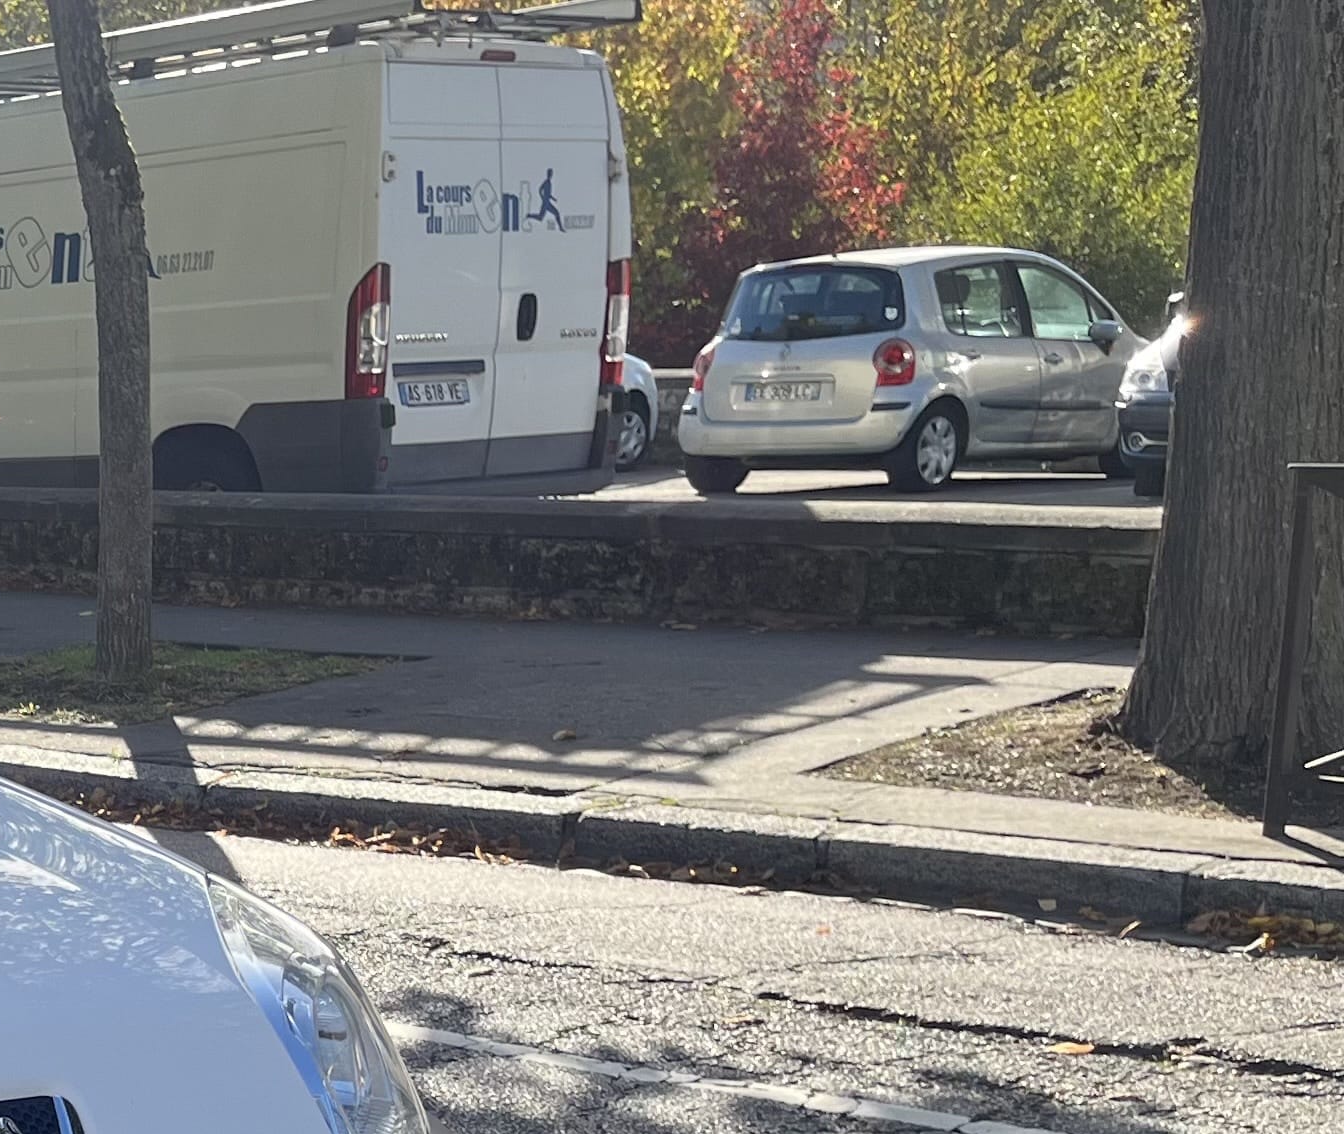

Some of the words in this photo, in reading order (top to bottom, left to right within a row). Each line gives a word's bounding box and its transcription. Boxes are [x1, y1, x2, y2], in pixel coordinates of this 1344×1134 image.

[416, 170, 433, 214] La
[436, 184, 472, 207] cours
[426, 205, 443, 235] du
